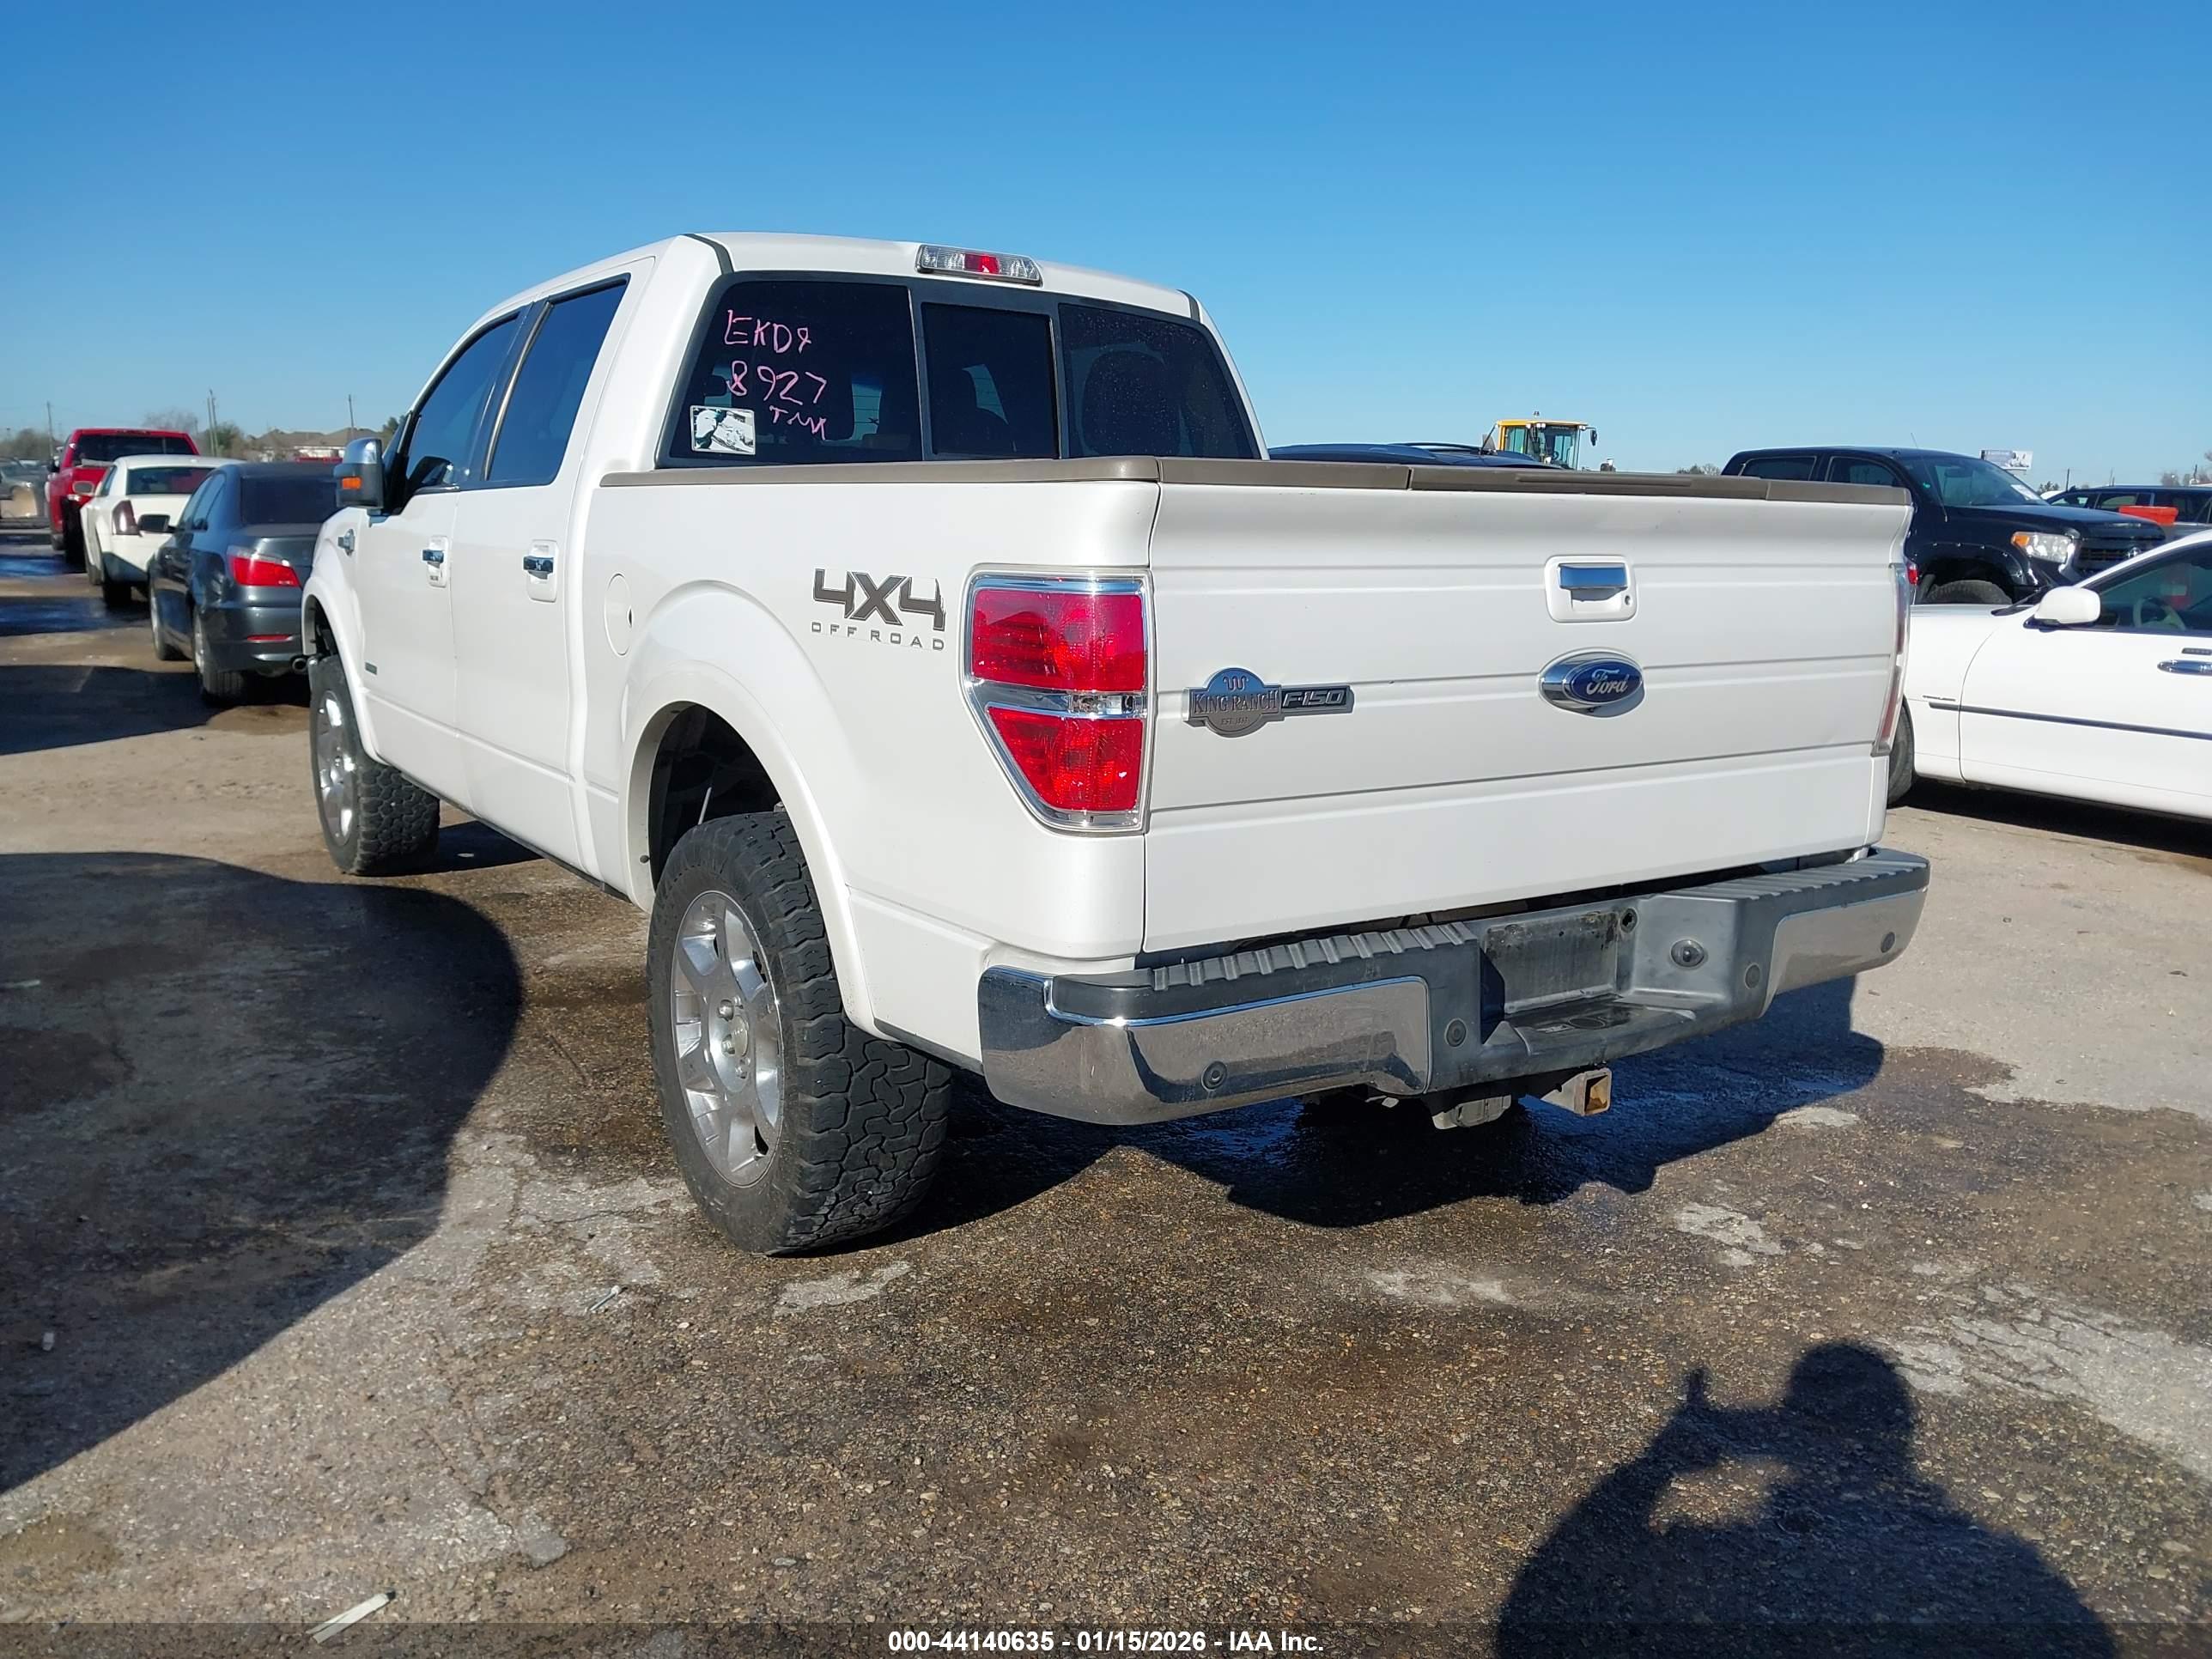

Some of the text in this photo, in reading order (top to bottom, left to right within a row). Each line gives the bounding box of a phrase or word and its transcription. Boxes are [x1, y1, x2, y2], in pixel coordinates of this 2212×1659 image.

[726, 360, 827, 405] 8927
[1586, 668, 1630, 696] Ford
[1194, 690, 1279, 714] KING RANCH
